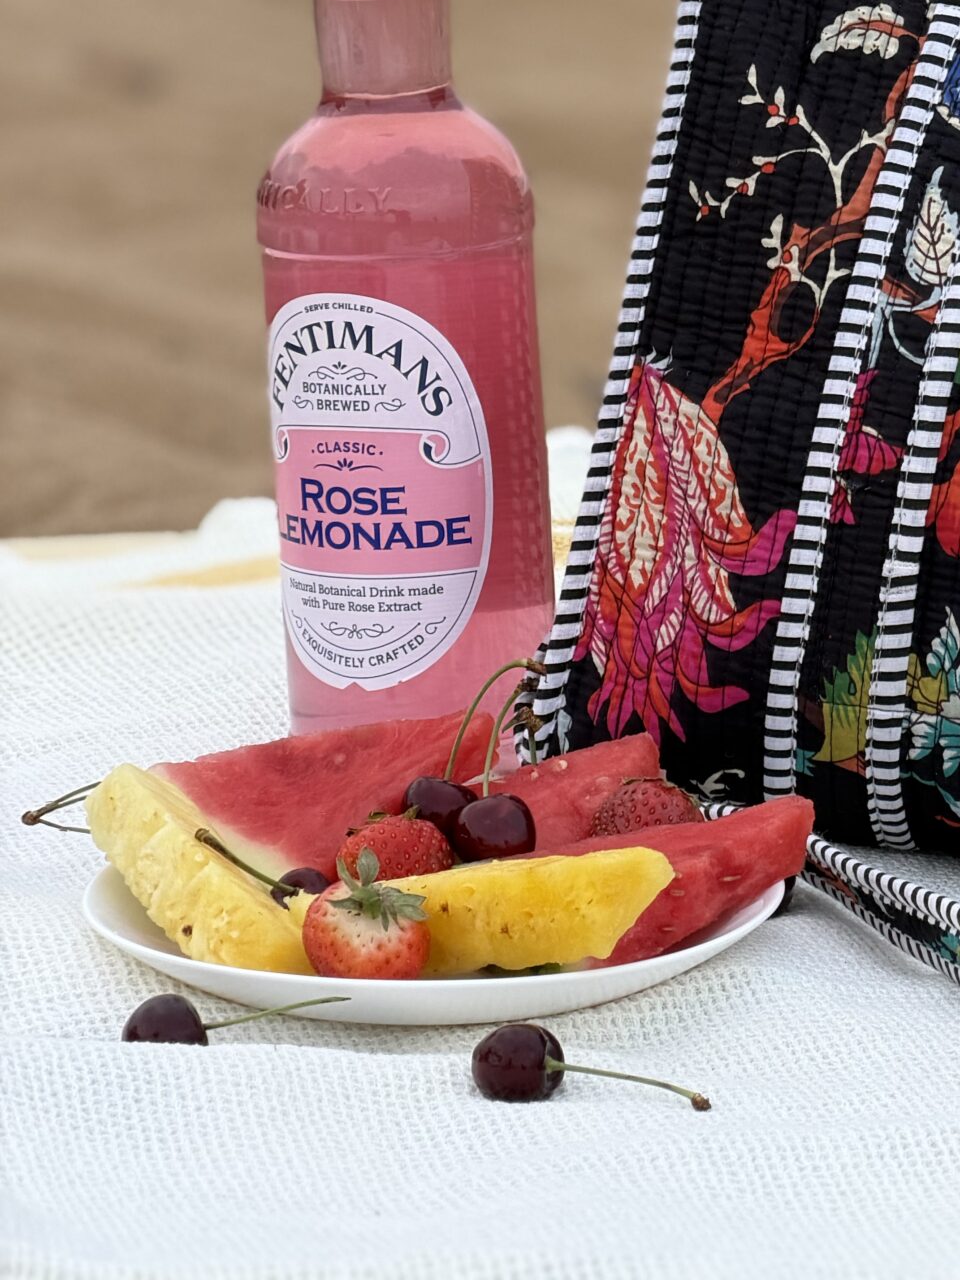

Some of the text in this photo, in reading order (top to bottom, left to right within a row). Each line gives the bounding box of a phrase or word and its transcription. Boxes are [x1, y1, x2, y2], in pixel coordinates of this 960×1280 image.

[304, 302, 374, 314] SERVE CHILLED
[272, 320, 453, 417] FENTIMANS
[302, 381, 387, 396] BOTANICALLY
[316, 399, 370, 412] BREWED
[316, 441, 376, 456] CLASSIC
[300, 477, 407, 516] ROSE
[289, 577, 444, 598] Natural Botanical Drink made
[301, 596, 422, 613] with Pure Rose Extract
[302, 628, 425, 669] EXQUISITELY CRAFTED
